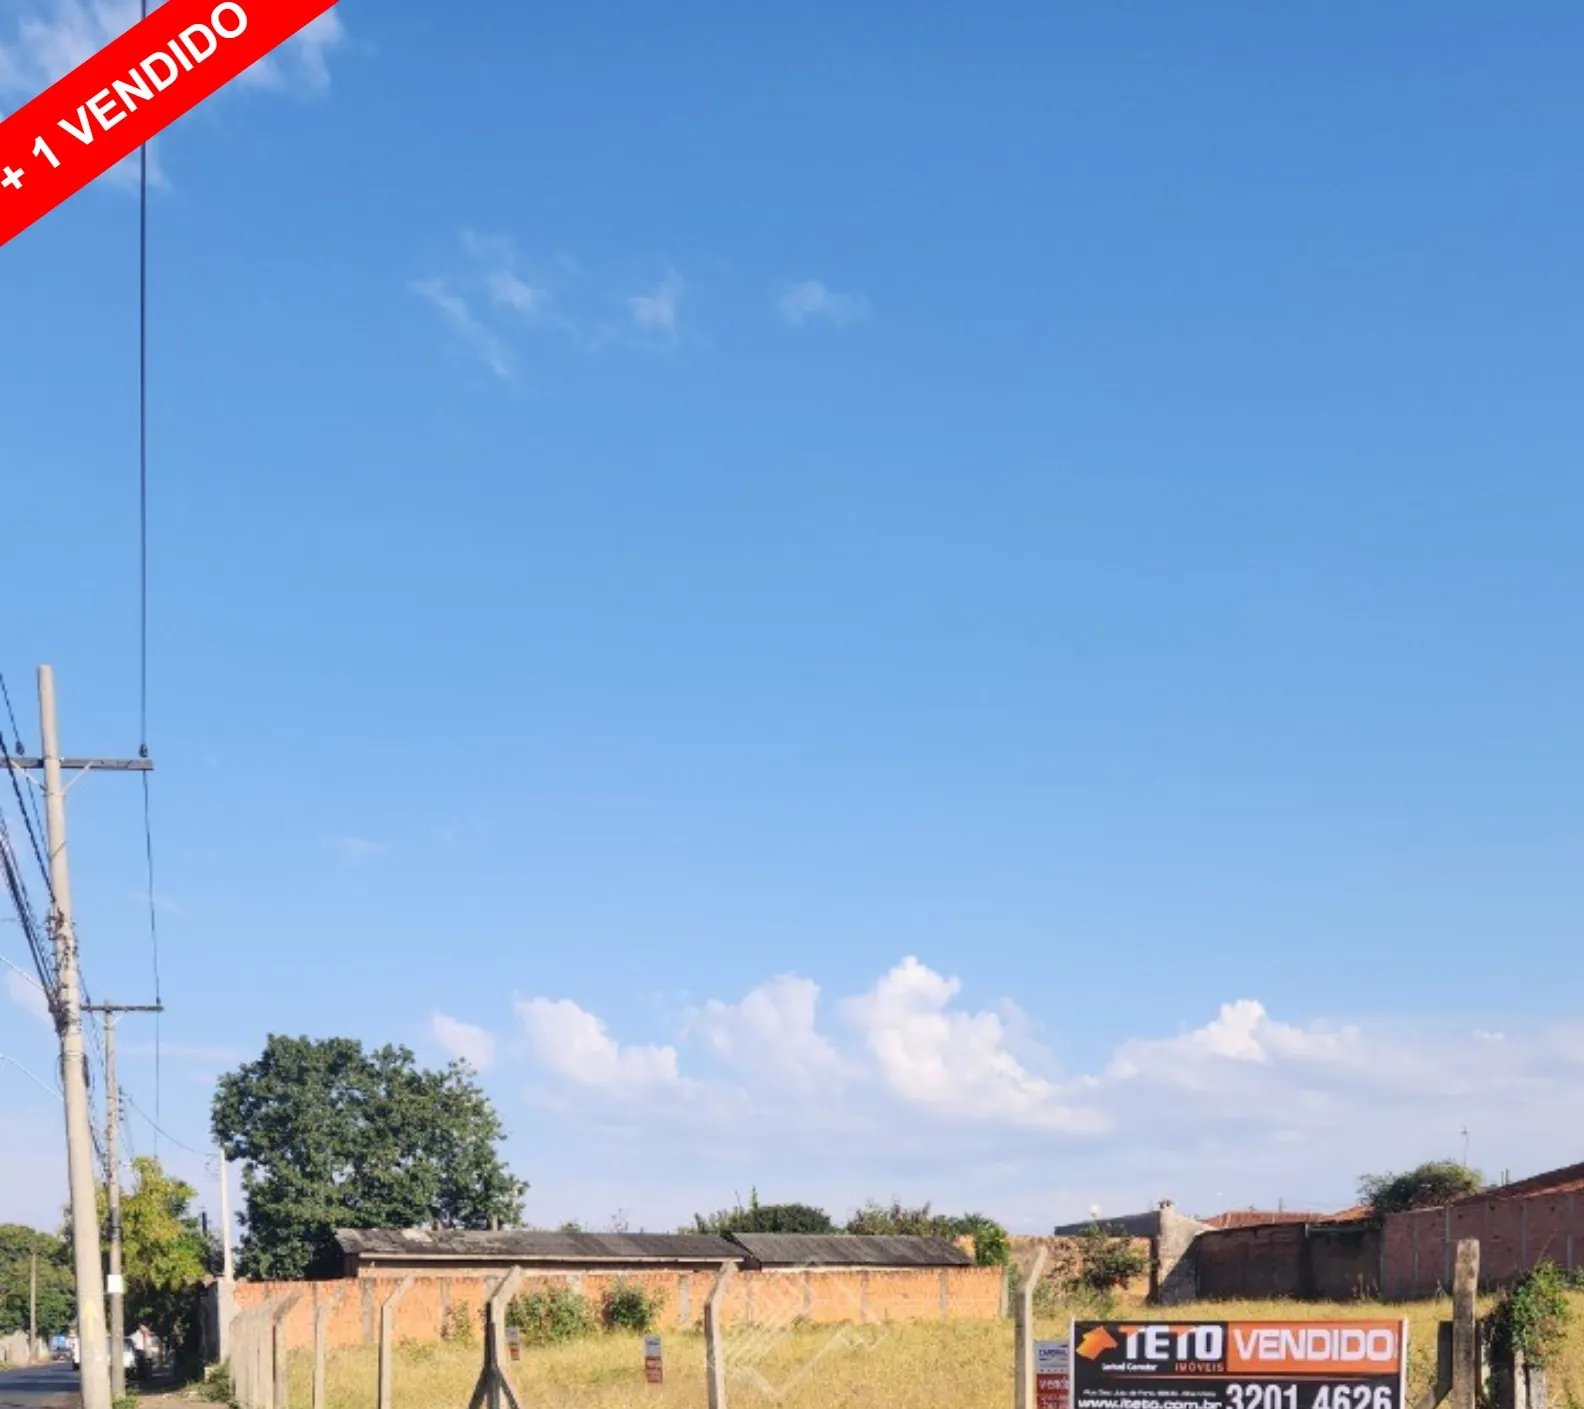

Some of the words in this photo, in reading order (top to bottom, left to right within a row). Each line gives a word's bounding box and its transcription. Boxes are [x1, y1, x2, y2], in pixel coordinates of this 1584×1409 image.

[1117, 1325, 1223, 1361] TETO
[1232, 1329, 1395, 1362] VENDIDO
[1174, 1361, 1225, 1372] IMÓVEIS
